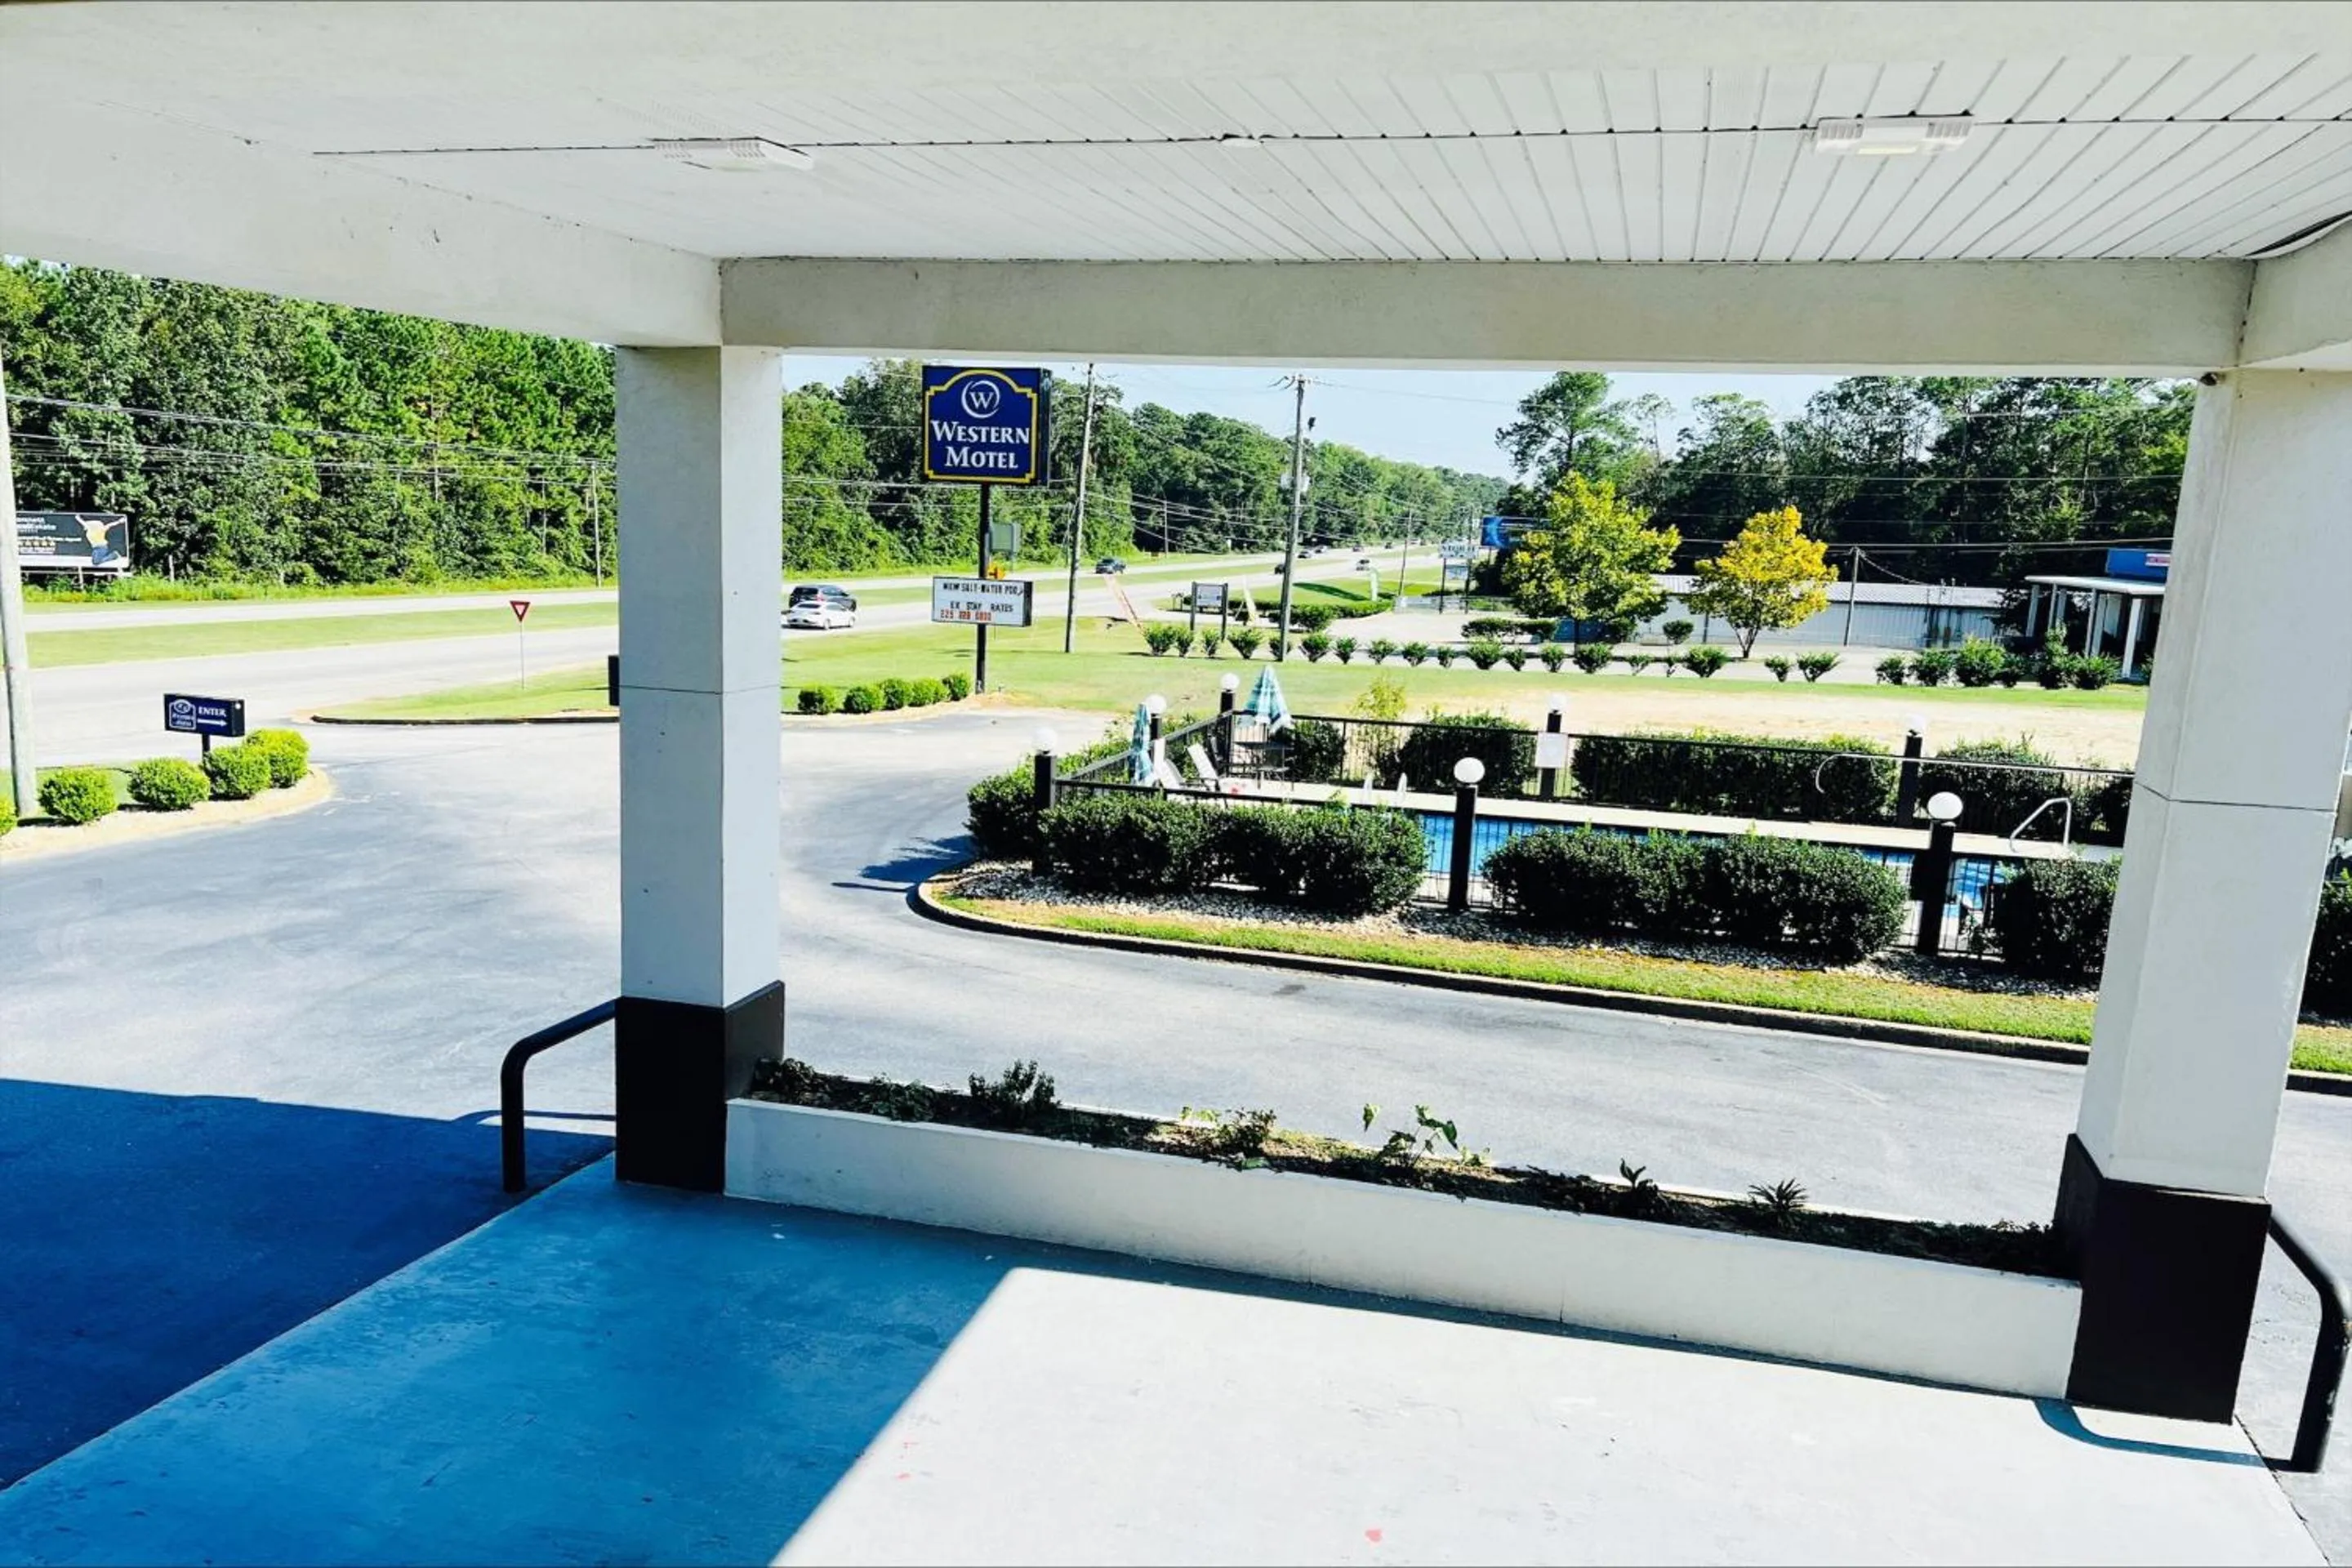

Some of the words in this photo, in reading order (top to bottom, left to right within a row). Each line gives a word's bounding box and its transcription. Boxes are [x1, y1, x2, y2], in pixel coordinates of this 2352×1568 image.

[969, 391, 995, 409] W
[930, 420, 1030, 444] WESTERN
[944, 446, 1018, 468] MOTEL
[991, 604, 1013, 612] RATES
[198, 706, 227, 718] ENTER
